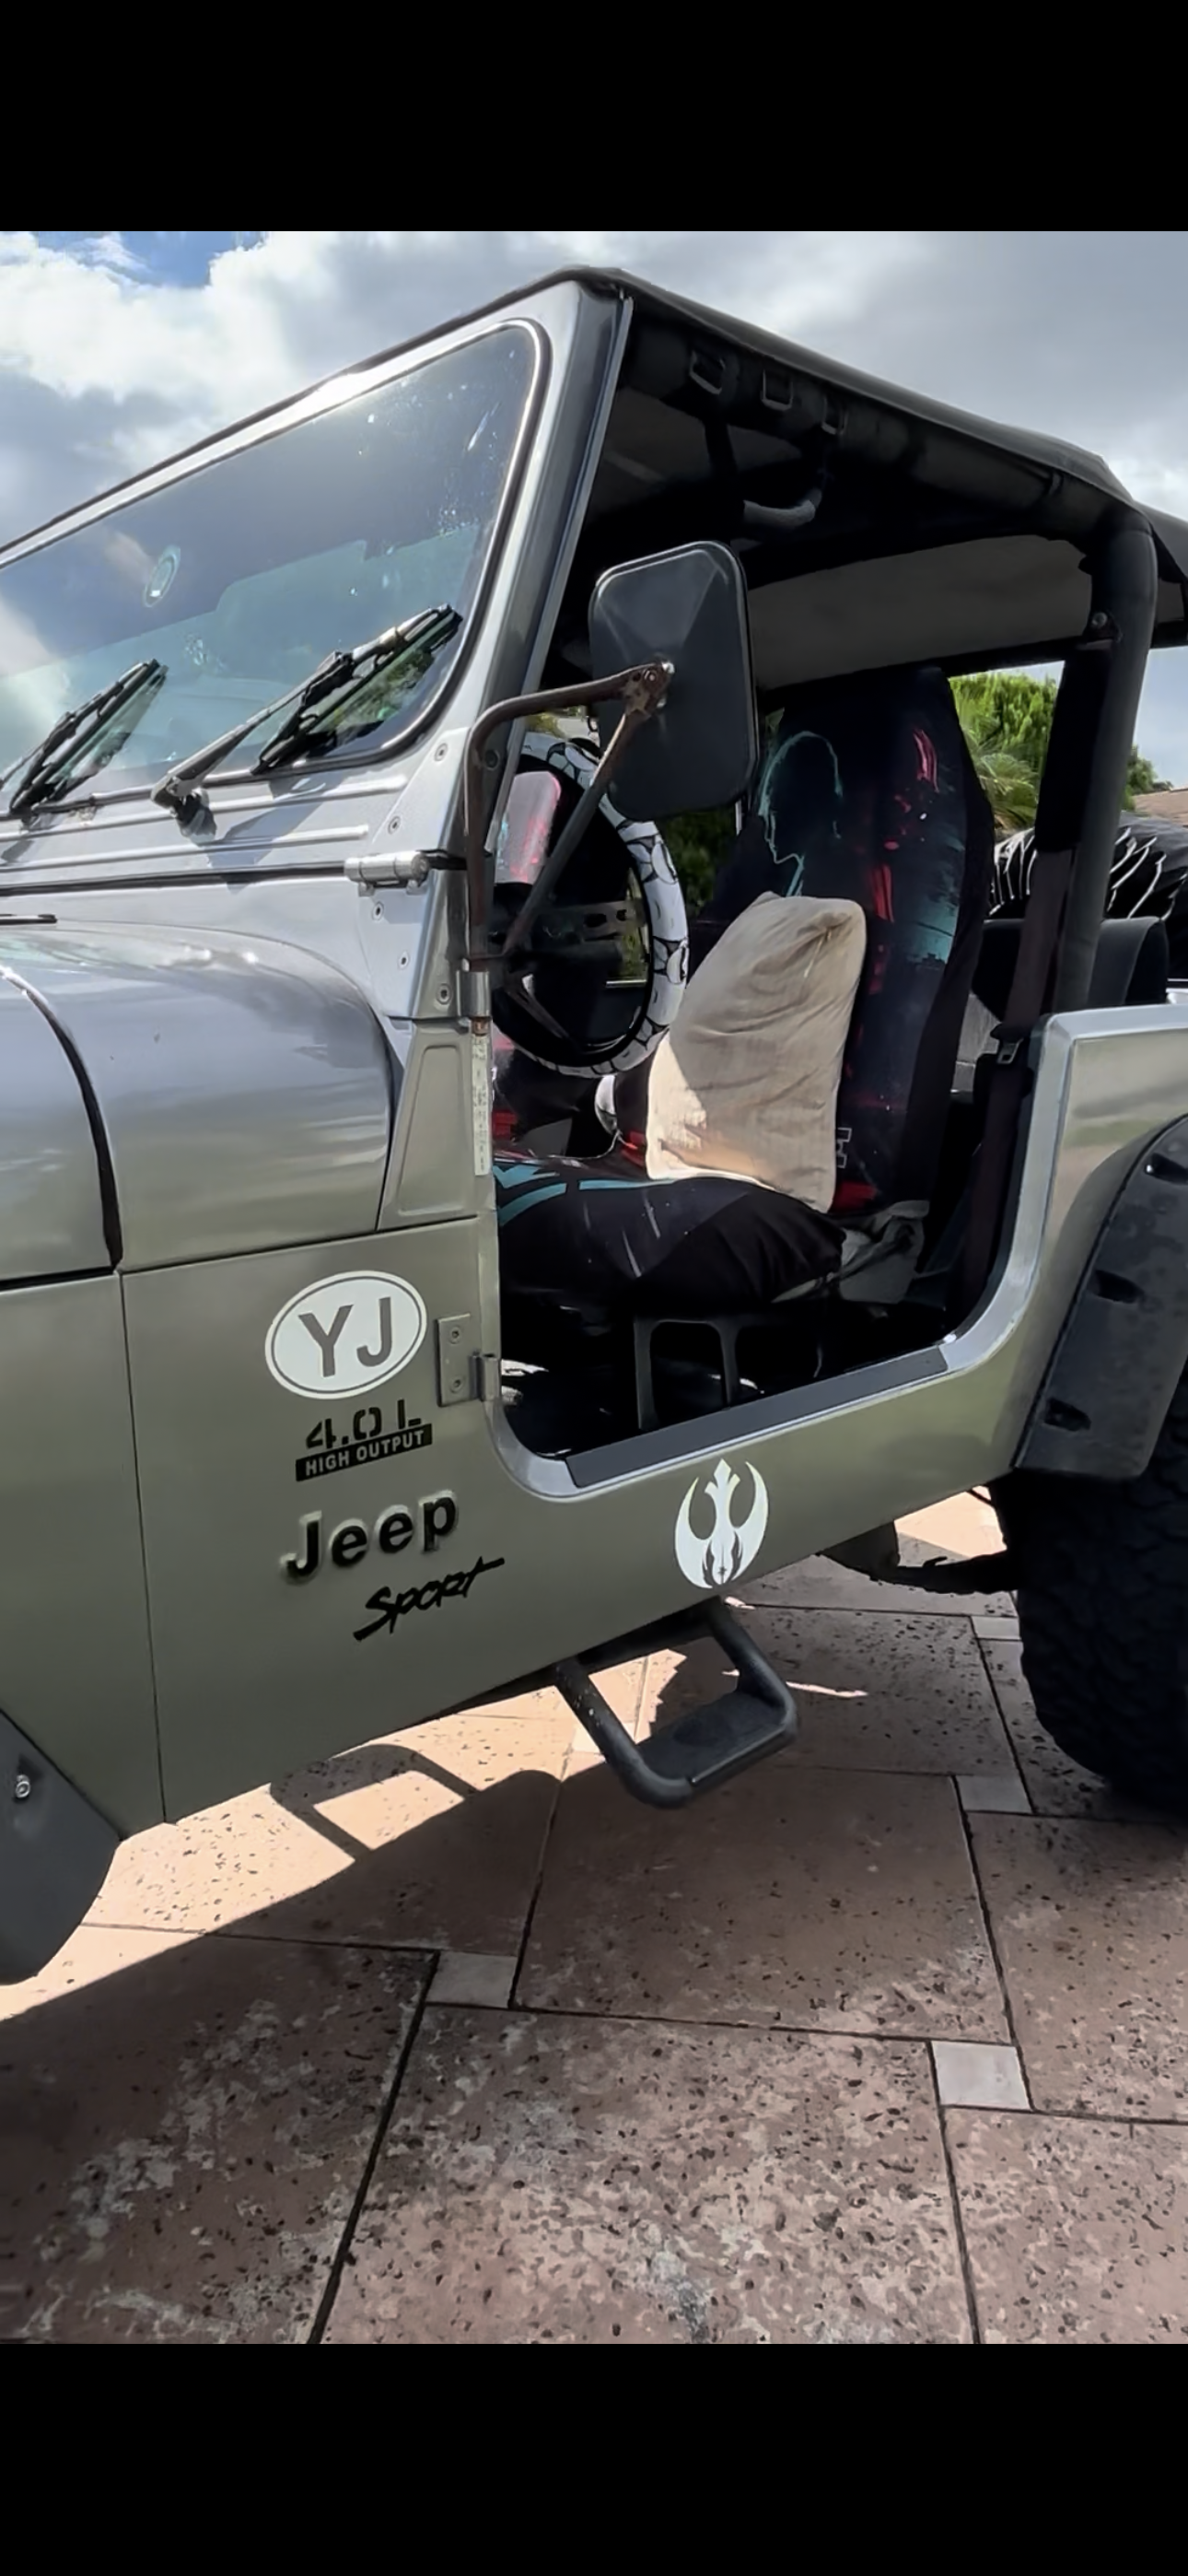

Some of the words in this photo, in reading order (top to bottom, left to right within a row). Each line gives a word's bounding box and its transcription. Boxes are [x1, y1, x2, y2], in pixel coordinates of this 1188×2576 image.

[298, 1296, 393, 1378] YJ
[305, 1449, 351, 1477] HIGH
[355, 1430, 425, 1461] OUTPUT
[306, 1407, 382, 1449] 4.0
[397, 1399, 422, 1430] L
[281, 1489, 459, 1584] Jeep
